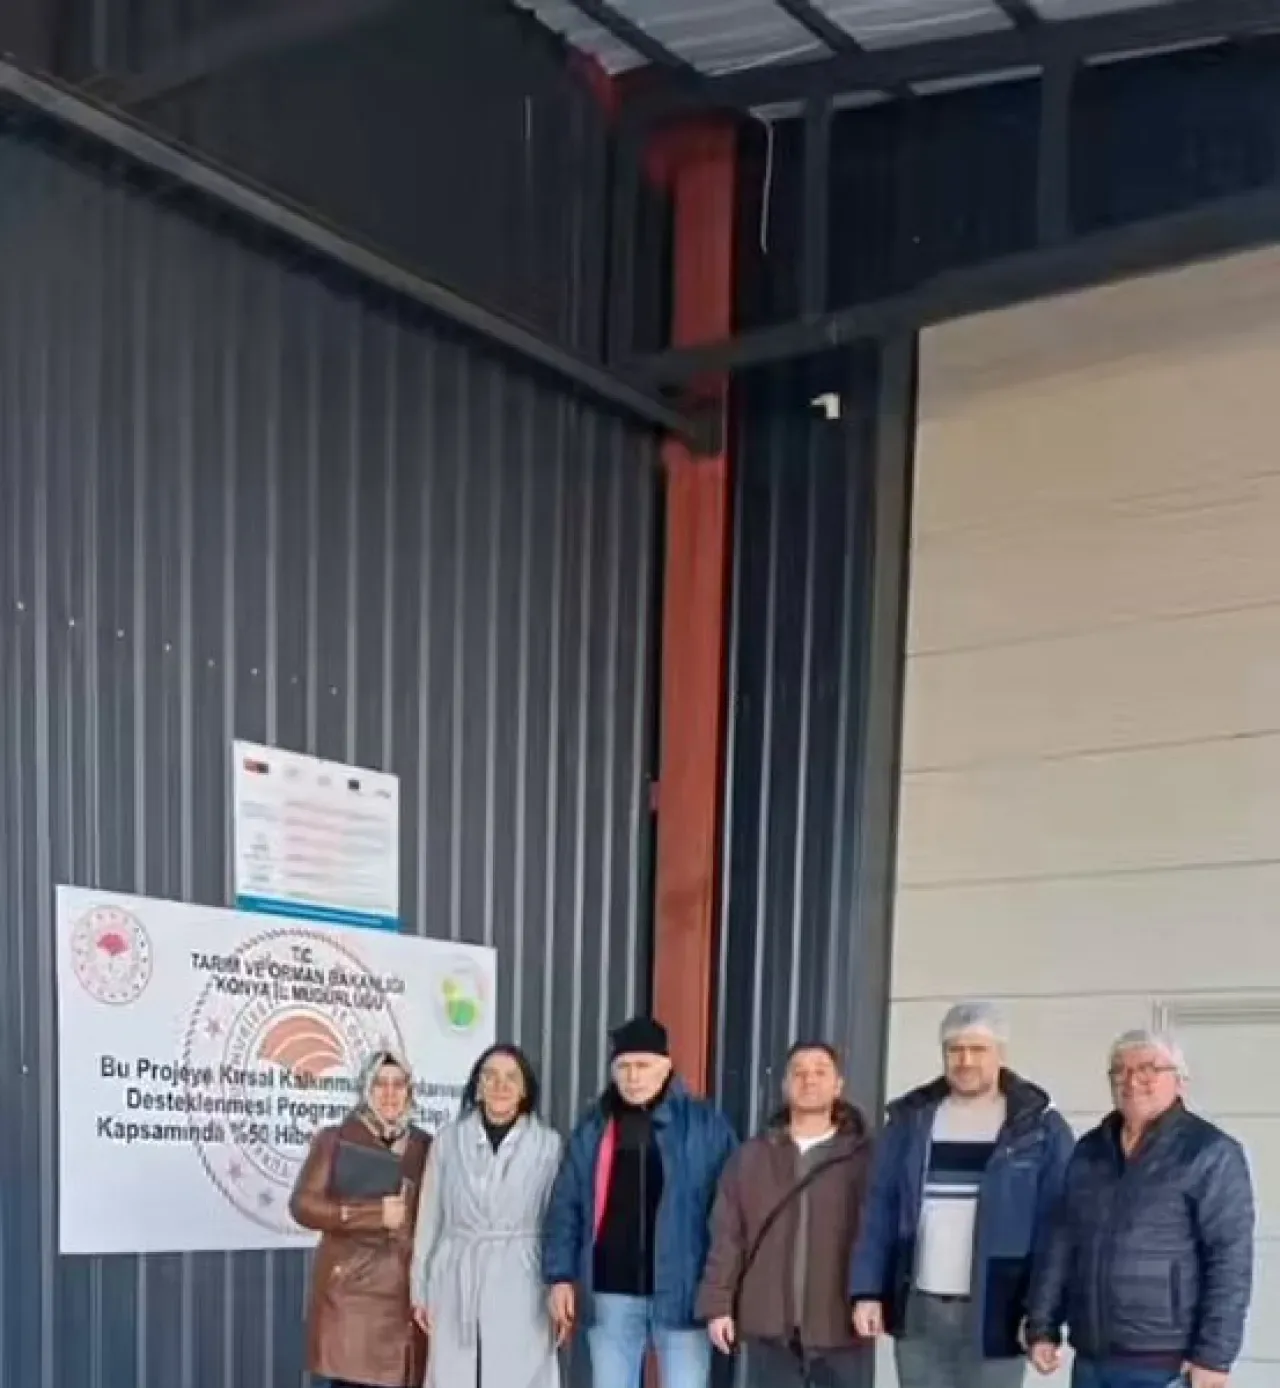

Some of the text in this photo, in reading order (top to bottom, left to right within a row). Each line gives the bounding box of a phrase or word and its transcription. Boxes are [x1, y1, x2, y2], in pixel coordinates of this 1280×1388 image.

[191, 952, 406, 994] TARIM VE ORMAN BAKANLIĞI
[216, 976, 269, 996] KONYA
[100, 1055, 130, 1079] Bu
[136, 1058, 214, 1087] Projeye
[218, 1064, 274, 1087] Kırsal
[126, 1087, 272, 1117] Desteklenmesi
[96, 1116, 225, 1144] Kapsamında
[229, 1121, 269, 1144] %50
